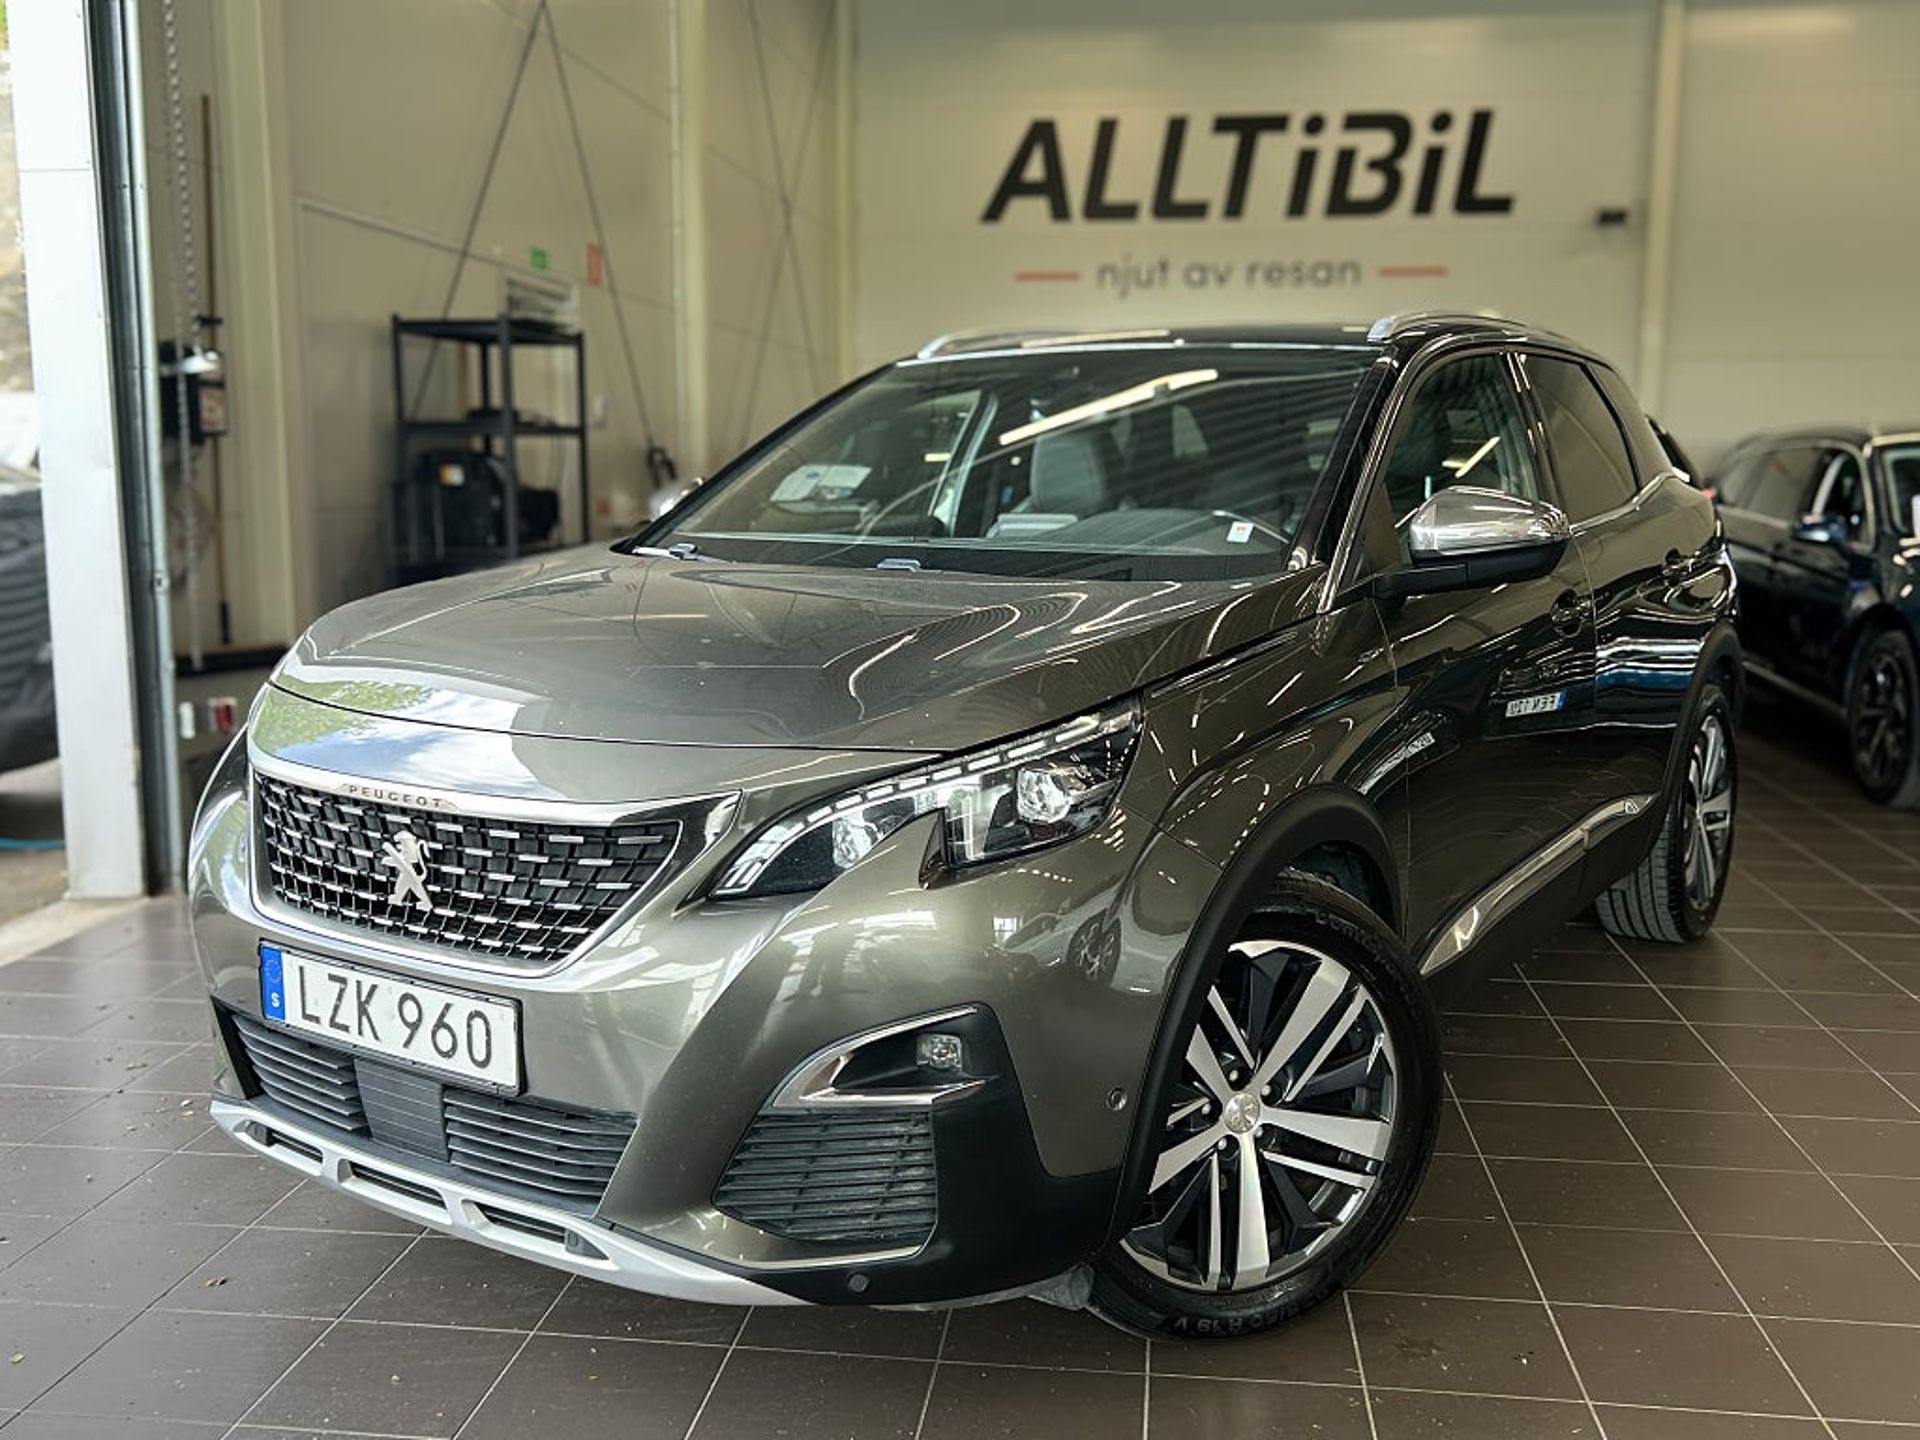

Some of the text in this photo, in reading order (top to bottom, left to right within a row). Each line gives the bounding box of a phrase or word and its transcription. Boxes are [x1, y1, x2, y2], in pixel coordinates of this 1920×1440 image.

[1096, 252, 1362, 299] njut av resan
[348, 784, 443, 808] PEUGEOT
[271, 992, 280, 1008] S
[299, 965, 492, 1069] LZK 960
